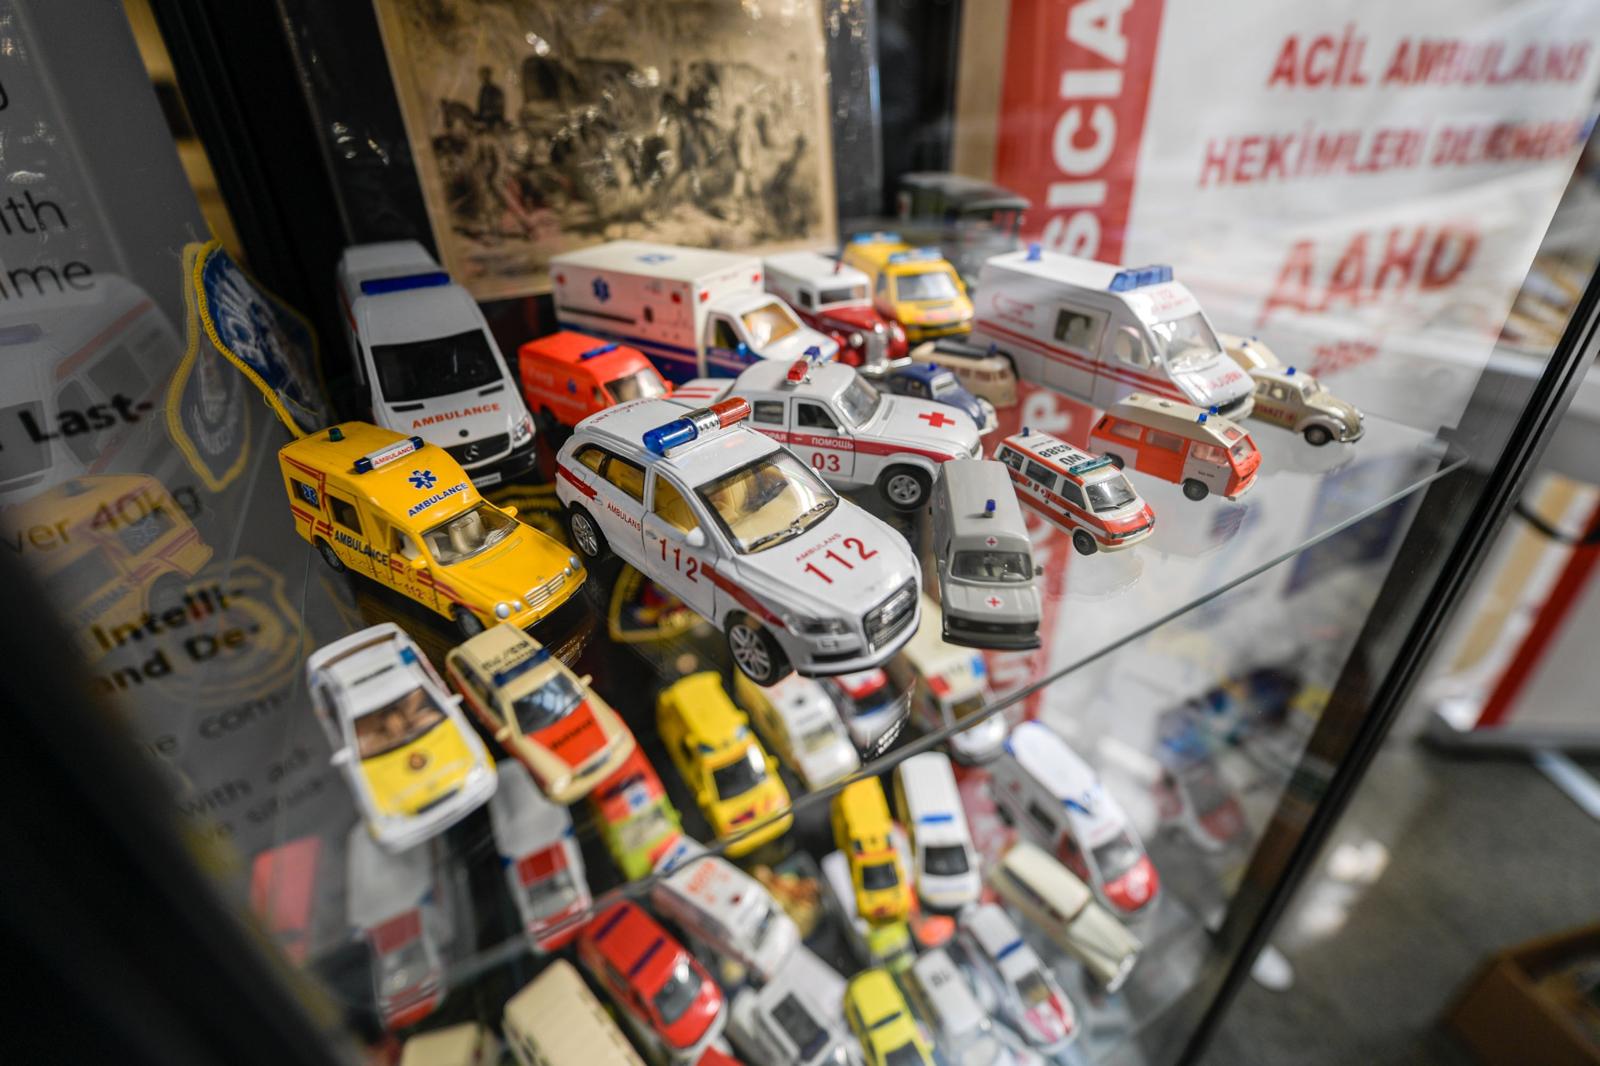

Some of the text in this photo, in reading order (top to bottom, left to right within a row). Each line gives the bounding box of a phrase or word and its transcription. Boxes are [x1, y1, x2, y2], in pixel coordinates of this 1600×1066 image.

[412, 403, 500, 429] AMBULANCE
[811, 436, 854, 450] ПОМОЩЬ
[811, 452, 841, 472] 03
[408, 482, 468, 517] AMBULANCE
[607, 501, 641, 532] AMBULANS
[335, 529, 389, 567] AMBULANCE
[659, 538, 698, 583] 112
[803, 536, 879, 584] 112
